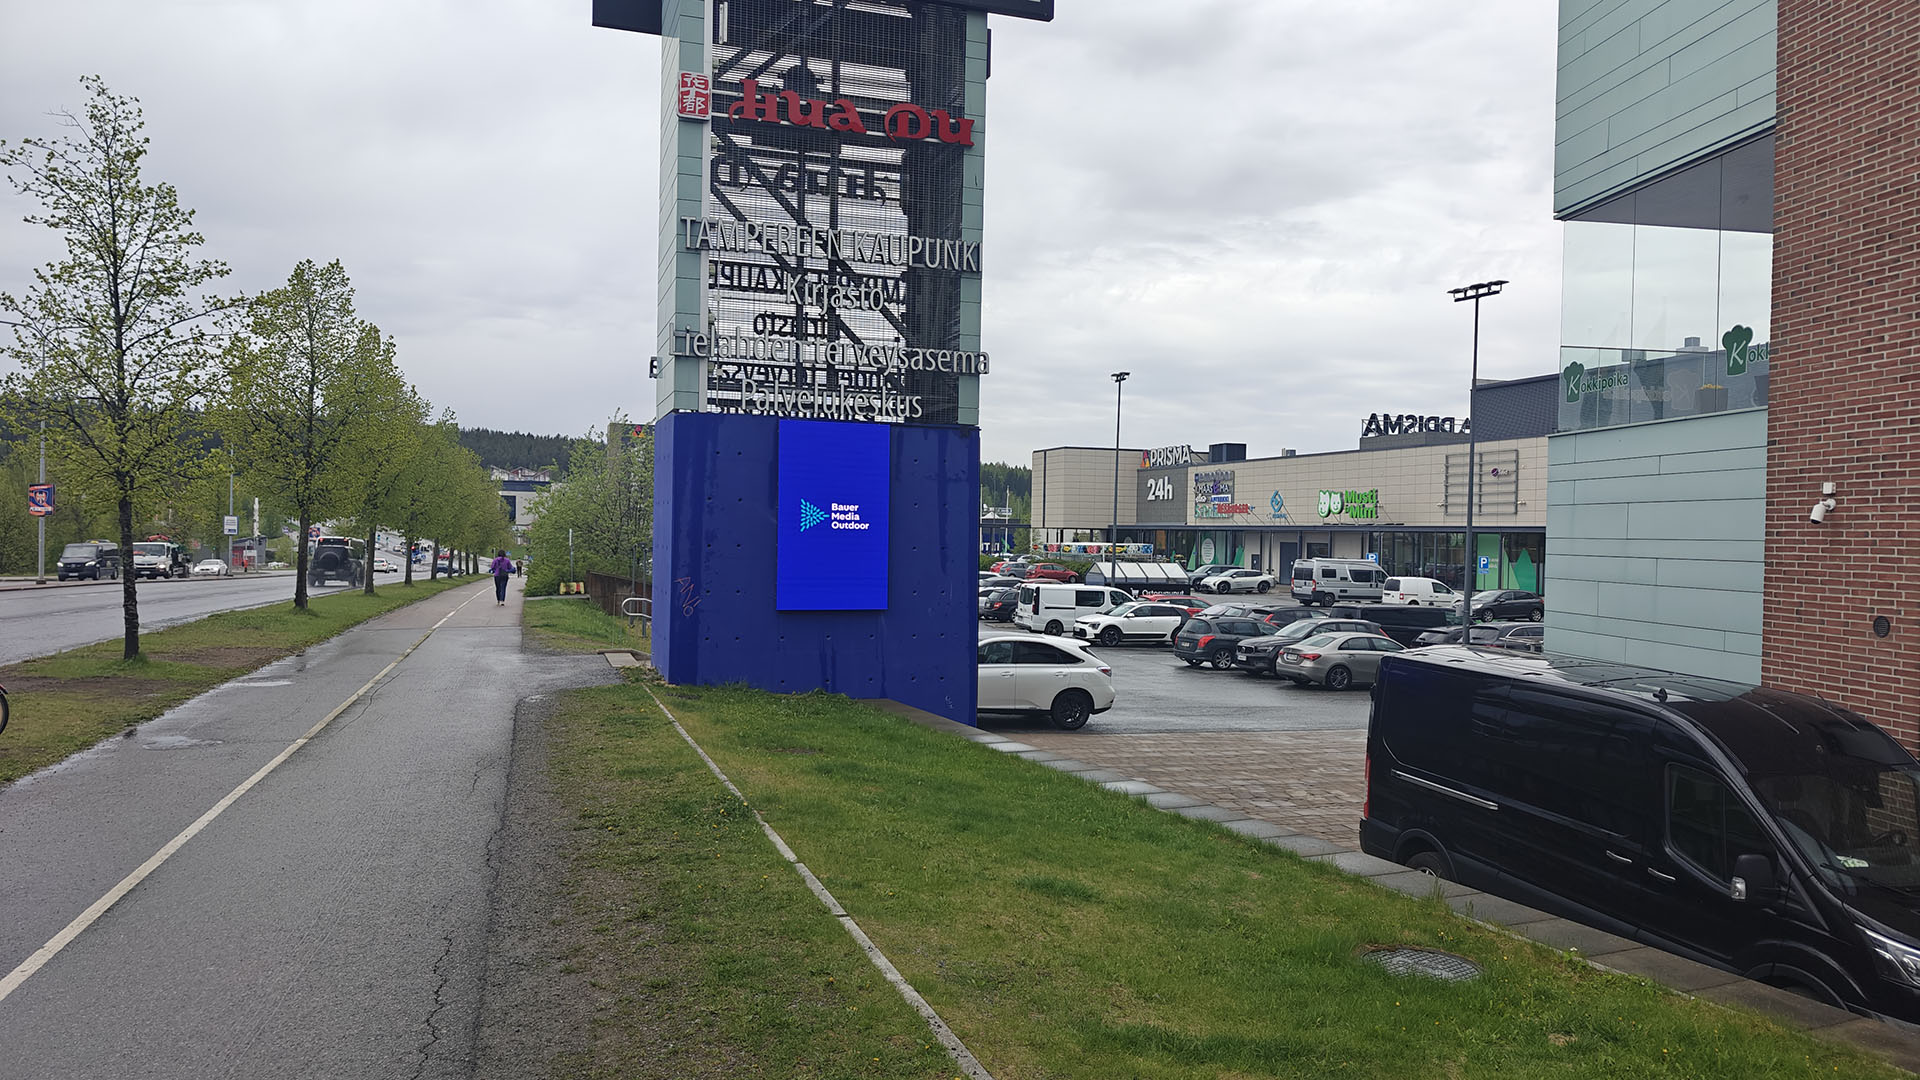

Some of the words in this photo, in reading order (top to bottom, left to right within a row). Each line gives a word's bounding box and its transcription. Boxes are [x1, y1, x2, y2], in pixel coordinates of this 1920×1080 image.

[681, 217, 840, 258] TAMPEREEN
[853, 230, 984, 272] KAUPUNKI
[785, 274, 885, 315] Kirjasto
[669, 323, 804, 362] Lielahden
[814, 338, 990, 376] terveysasema
[1569, 372, 1629, 396] Kokkipoika
[741, 379, 922, 418] Palvelukeskus
[1150, 445, 1190, 466] PRISMA
[1147, 476, 1173, 500] 24h
[1345, 488, 1376, 503] Musti
[831, 503, 859, 511] Bauer
[831, 512, 860, 520] Media
[831, 521, 870, 529] Outdoor
